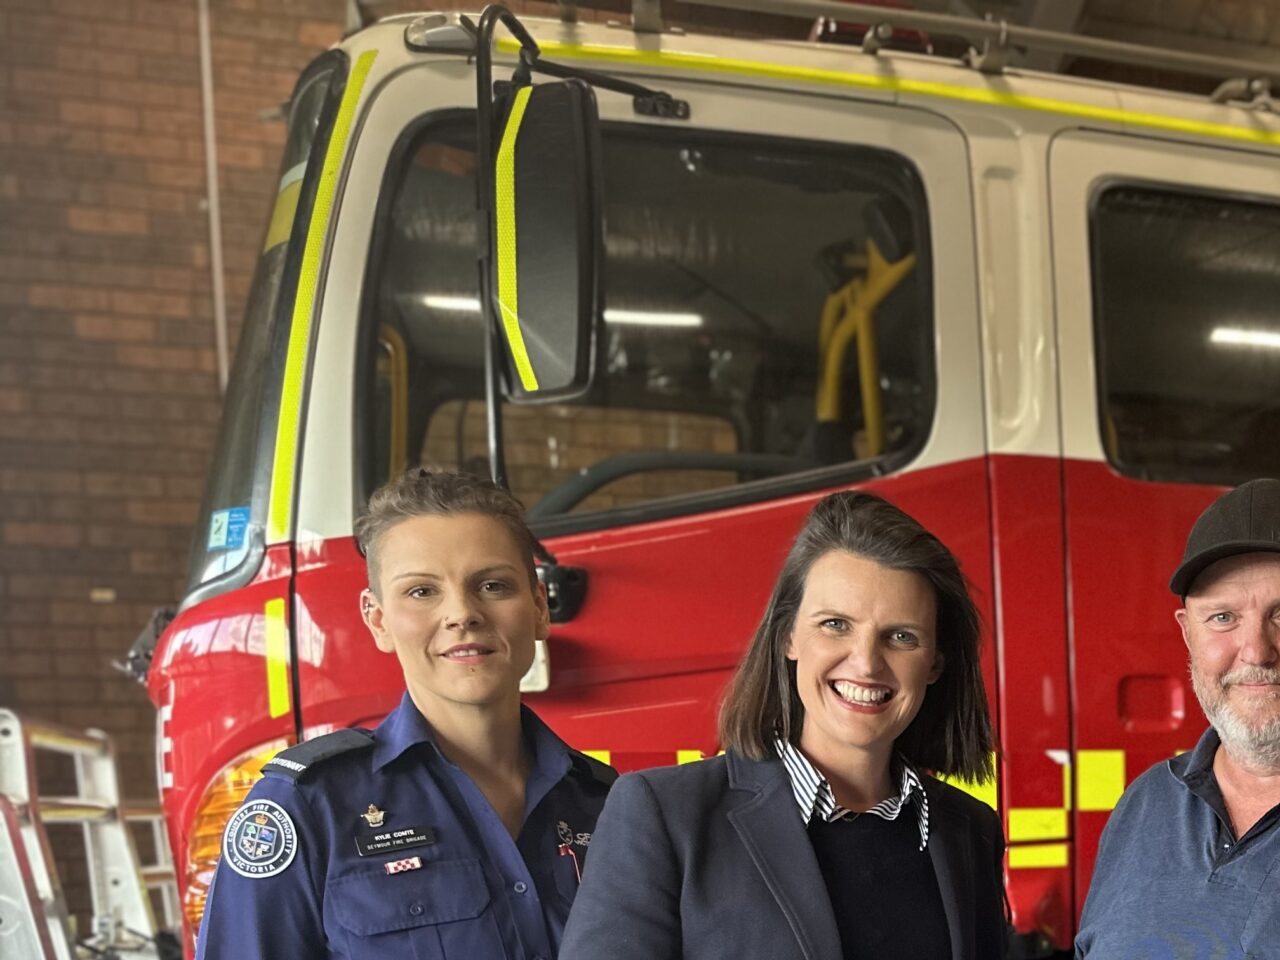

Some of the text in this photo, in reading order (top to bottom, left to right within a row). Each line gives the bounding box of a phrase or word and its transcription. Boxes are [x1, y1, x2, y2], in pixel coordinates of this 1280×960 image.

[228, 804, 293, 855] COUNTRY FIRE AUTHORITY
[233, 856, 276, 873] VICTORIA
